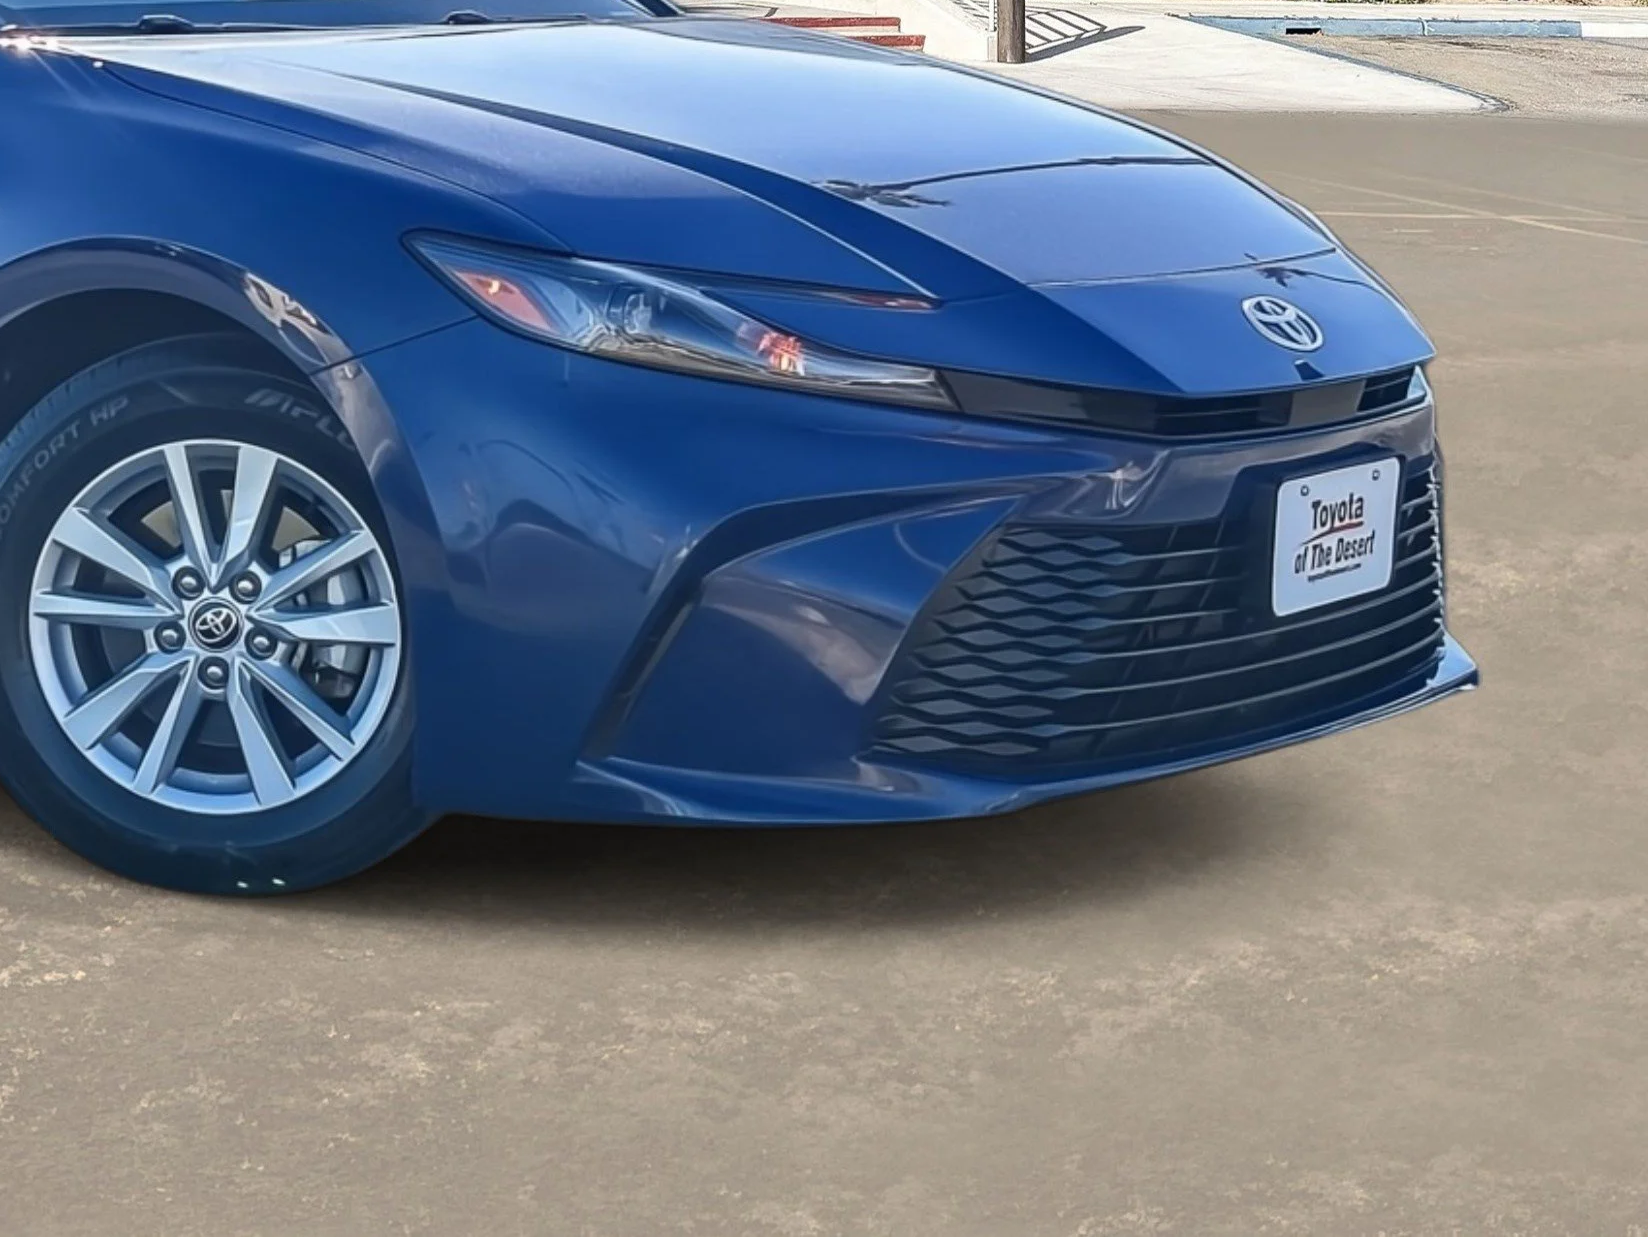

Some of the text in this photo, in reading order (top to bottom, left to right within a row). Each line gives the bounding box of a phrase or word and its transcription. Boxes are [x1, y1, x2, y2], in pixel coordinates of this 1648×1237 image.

[89, 394, 129, 426] HP
[1311, 492, 1364, 530] Toyota
[1294, 546, 1309, 574] of
[1311, 542, 1333, 570] The
[1335, 529, 1376, 563] Desert
